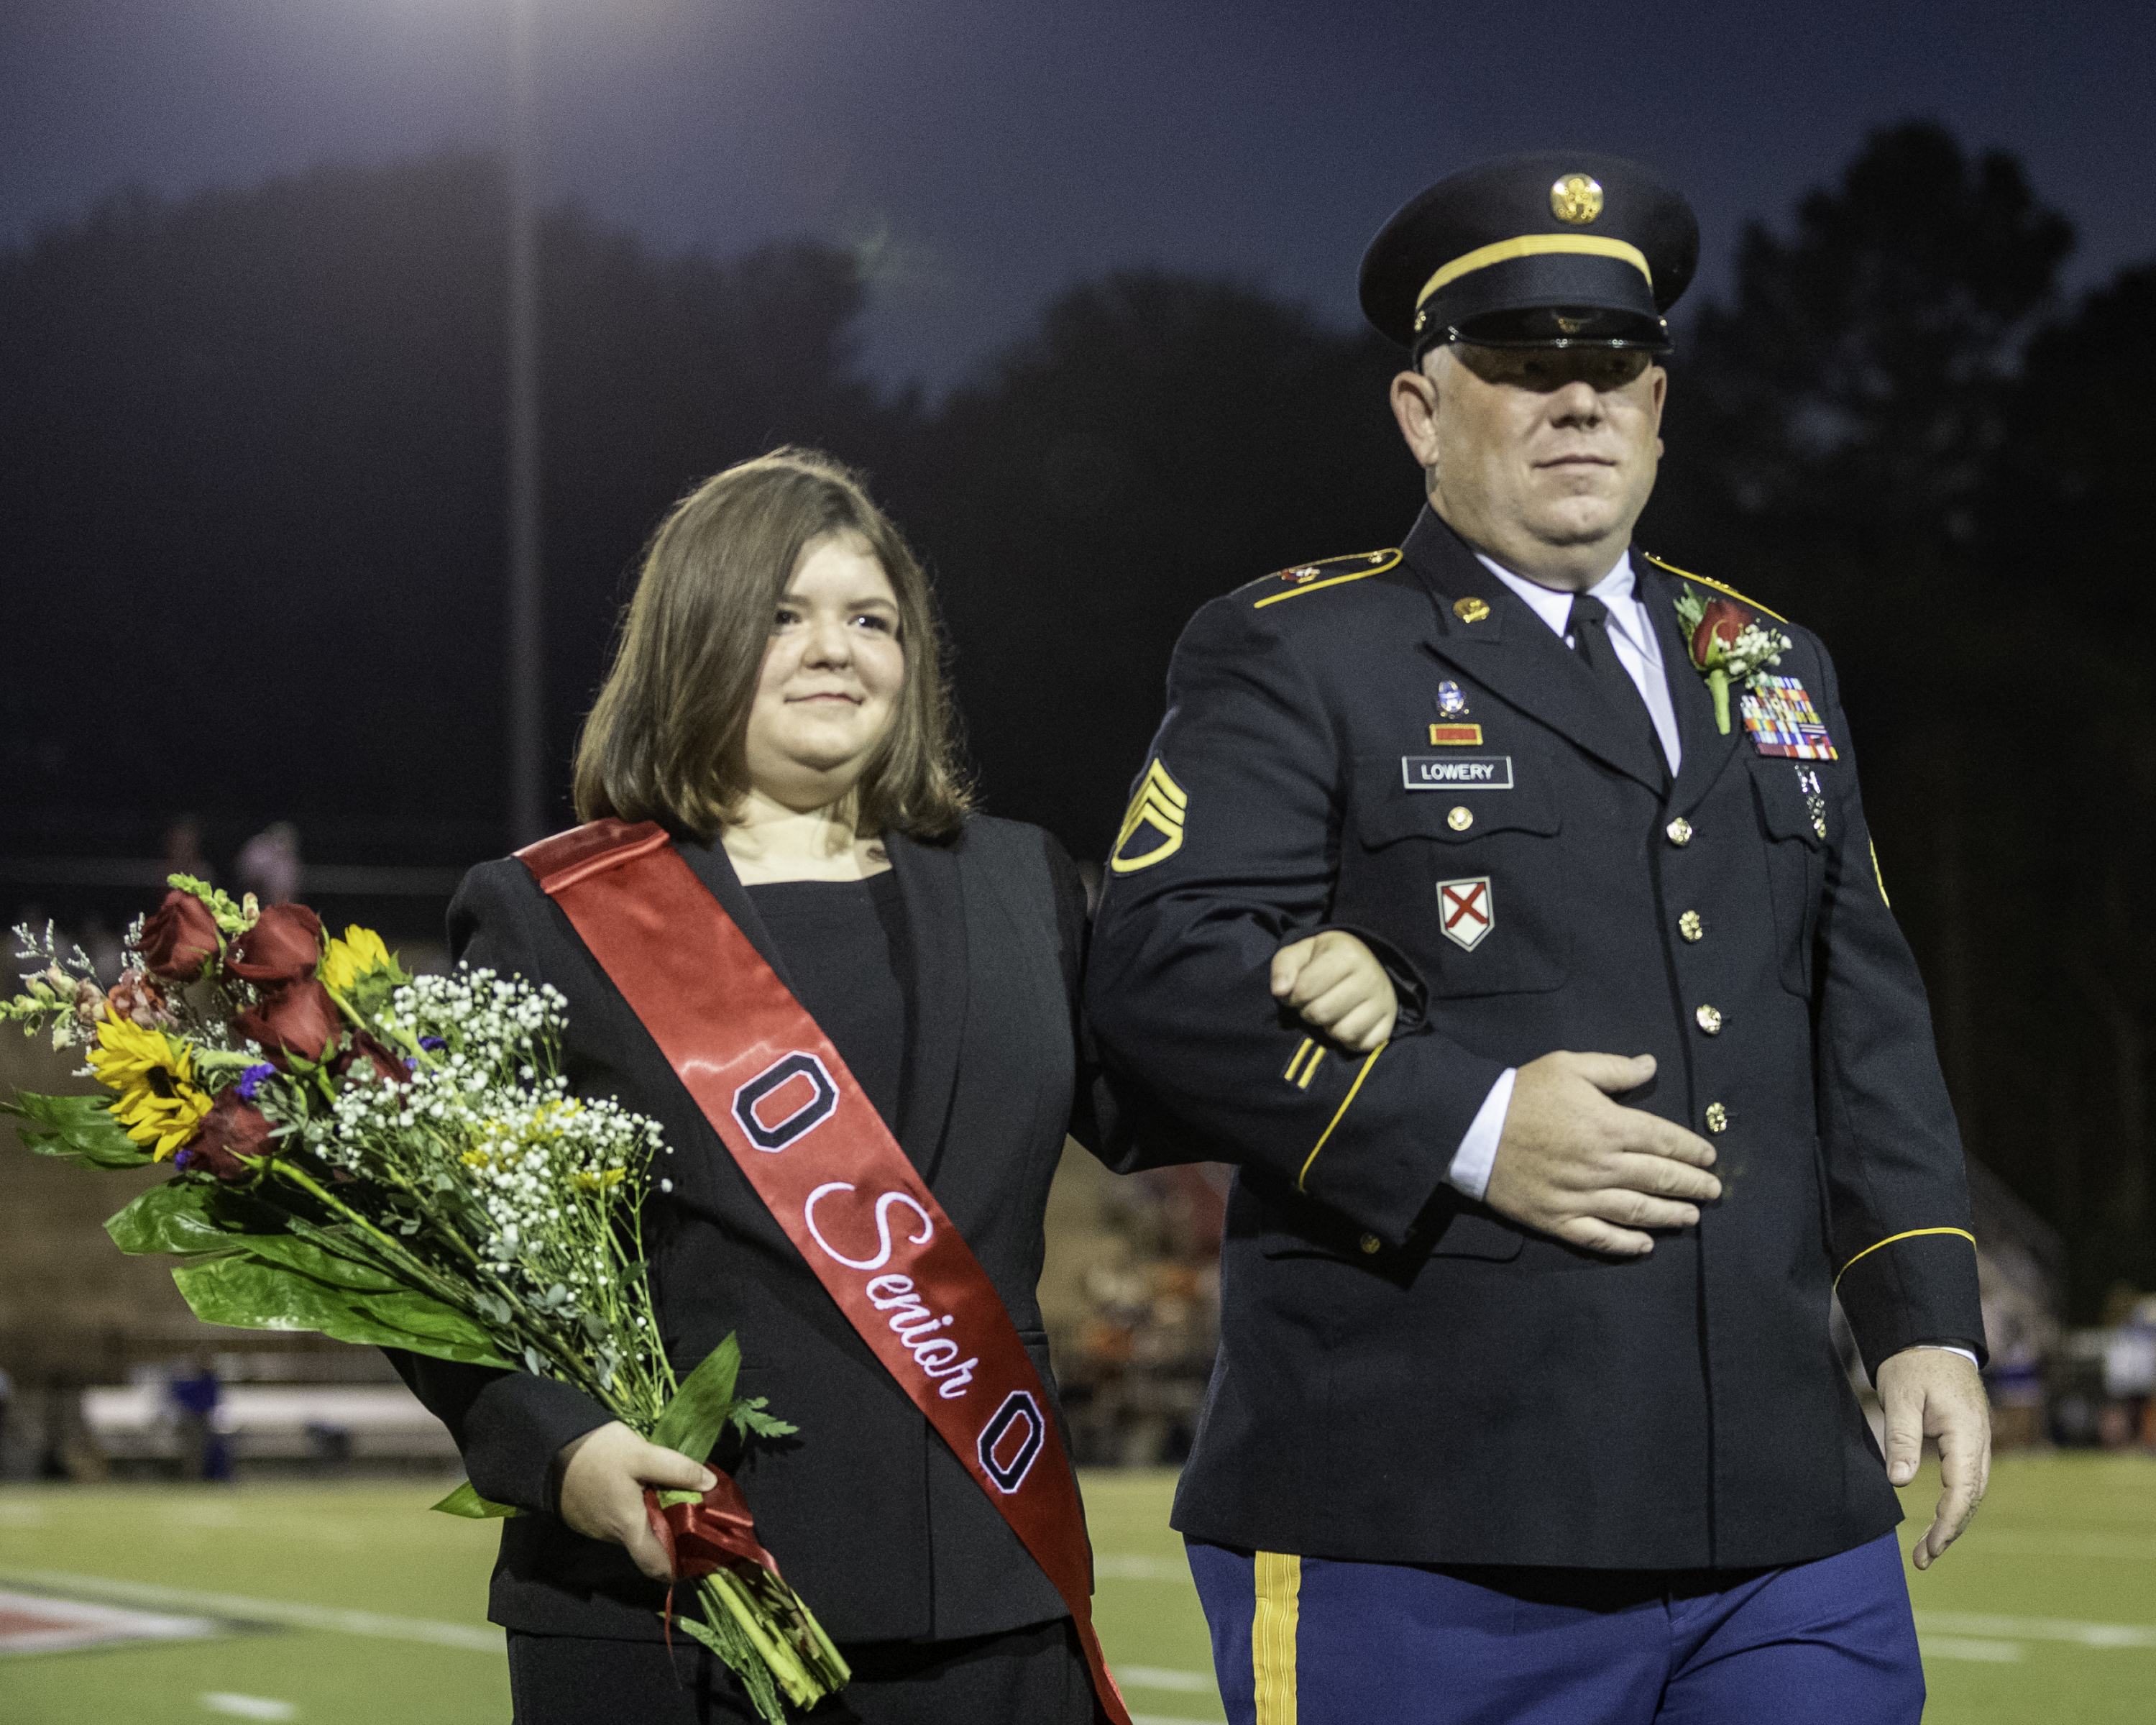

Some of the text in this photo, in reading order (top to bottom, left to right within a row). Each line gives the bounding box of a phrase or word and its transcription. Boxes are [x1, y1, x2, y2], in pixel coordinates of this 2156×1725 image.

[1421, 764, 1494, 780] LOWERY
[731, 1050, 1044, 1493] O Senior O
